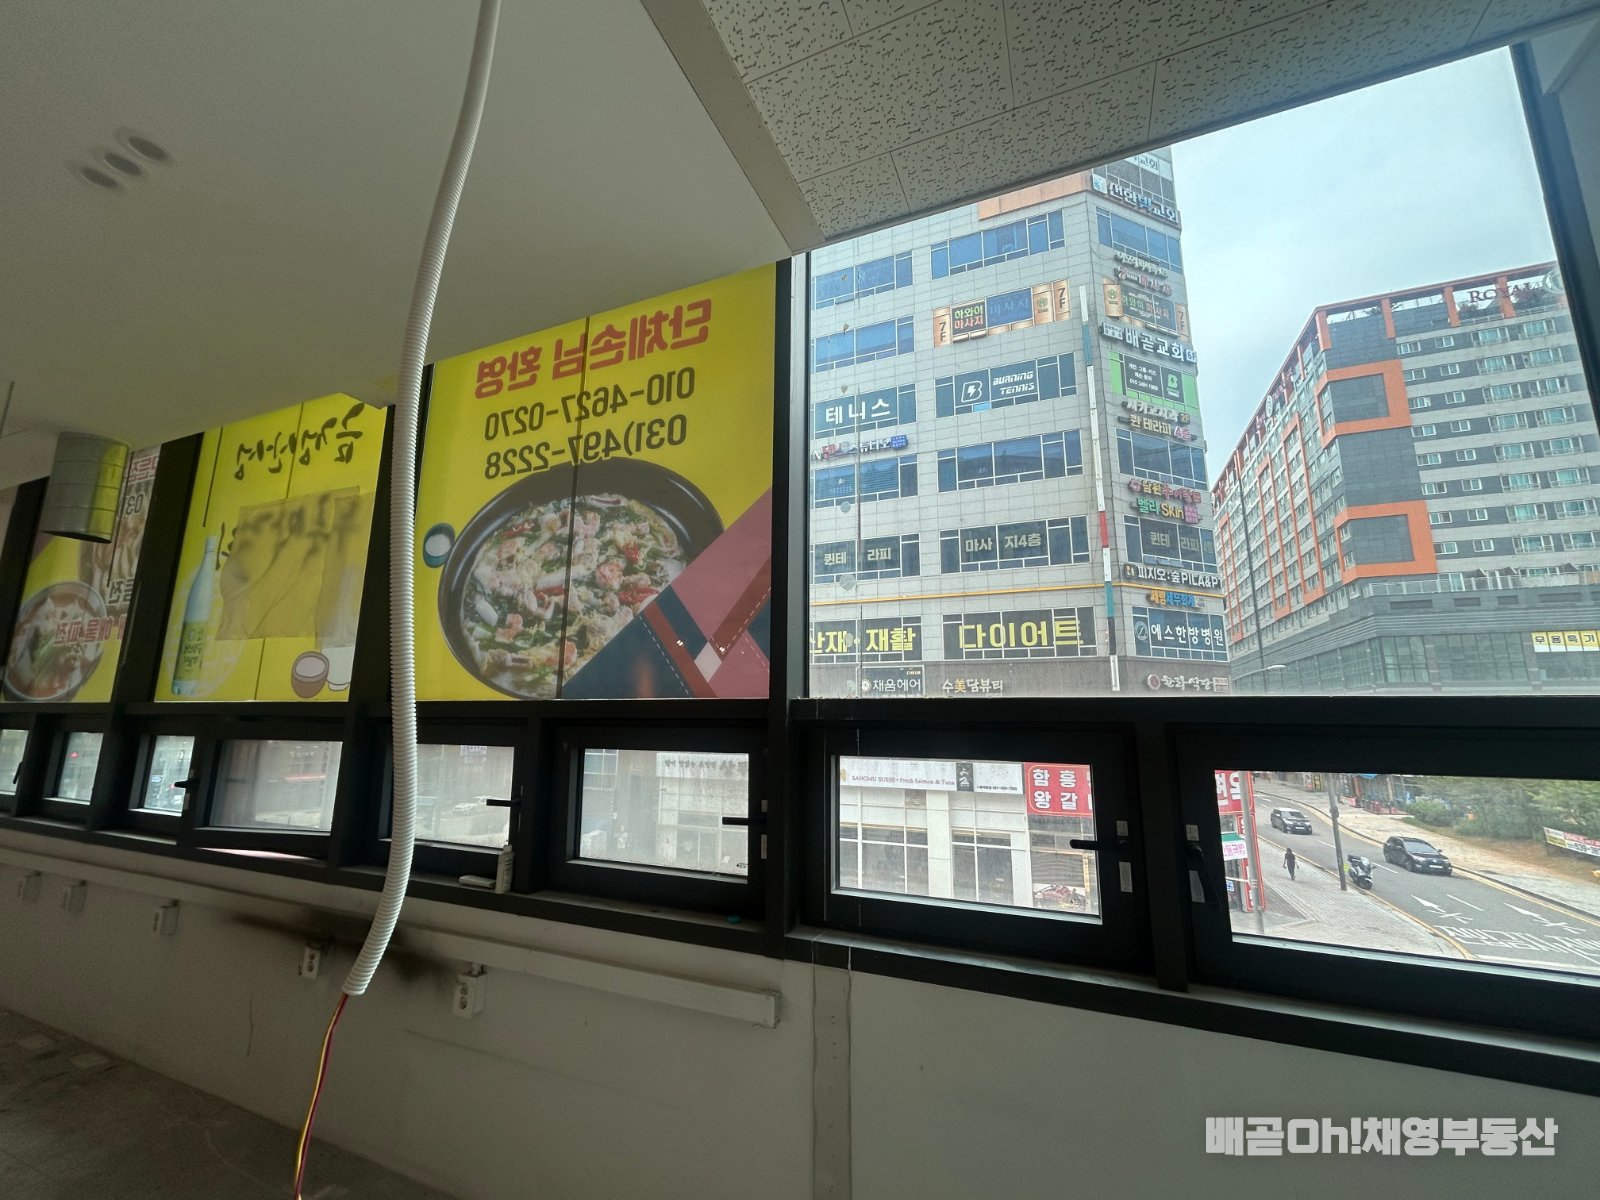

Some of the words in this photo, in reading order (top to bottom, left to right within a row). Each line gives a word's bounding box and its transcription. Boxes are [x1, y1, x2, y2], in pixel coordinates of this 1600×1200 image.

[1134, 155, 1159, 170] 교회
[954, 305, 983, 319] 하와이
[954, 315, 983, 329] 마사지
[1125, 327, 1184, 362] 배곧교회
[825, 398, 891, 425] 테니스
[1143, 417, 1172, 435] 테라피
[1161, 503, 1185, 519] Skin
[965, 537, 992, 552] 마사
[1004, 532, 1041, 549] 지4층
[823, 551, 847, 566] 퀸테
[867, 547, 891, 561] 라피
[865, 627, 917, 651] 재활
[959, 619, 1083, 649] 다이어트
[1151, 623, 1224, 646] 에스한방병원
[872, 678, 921, 692] 채움헤어
[1033, 769, 1090, 788] 함흥
[1034, 790, 1092, 810] 왕갈
